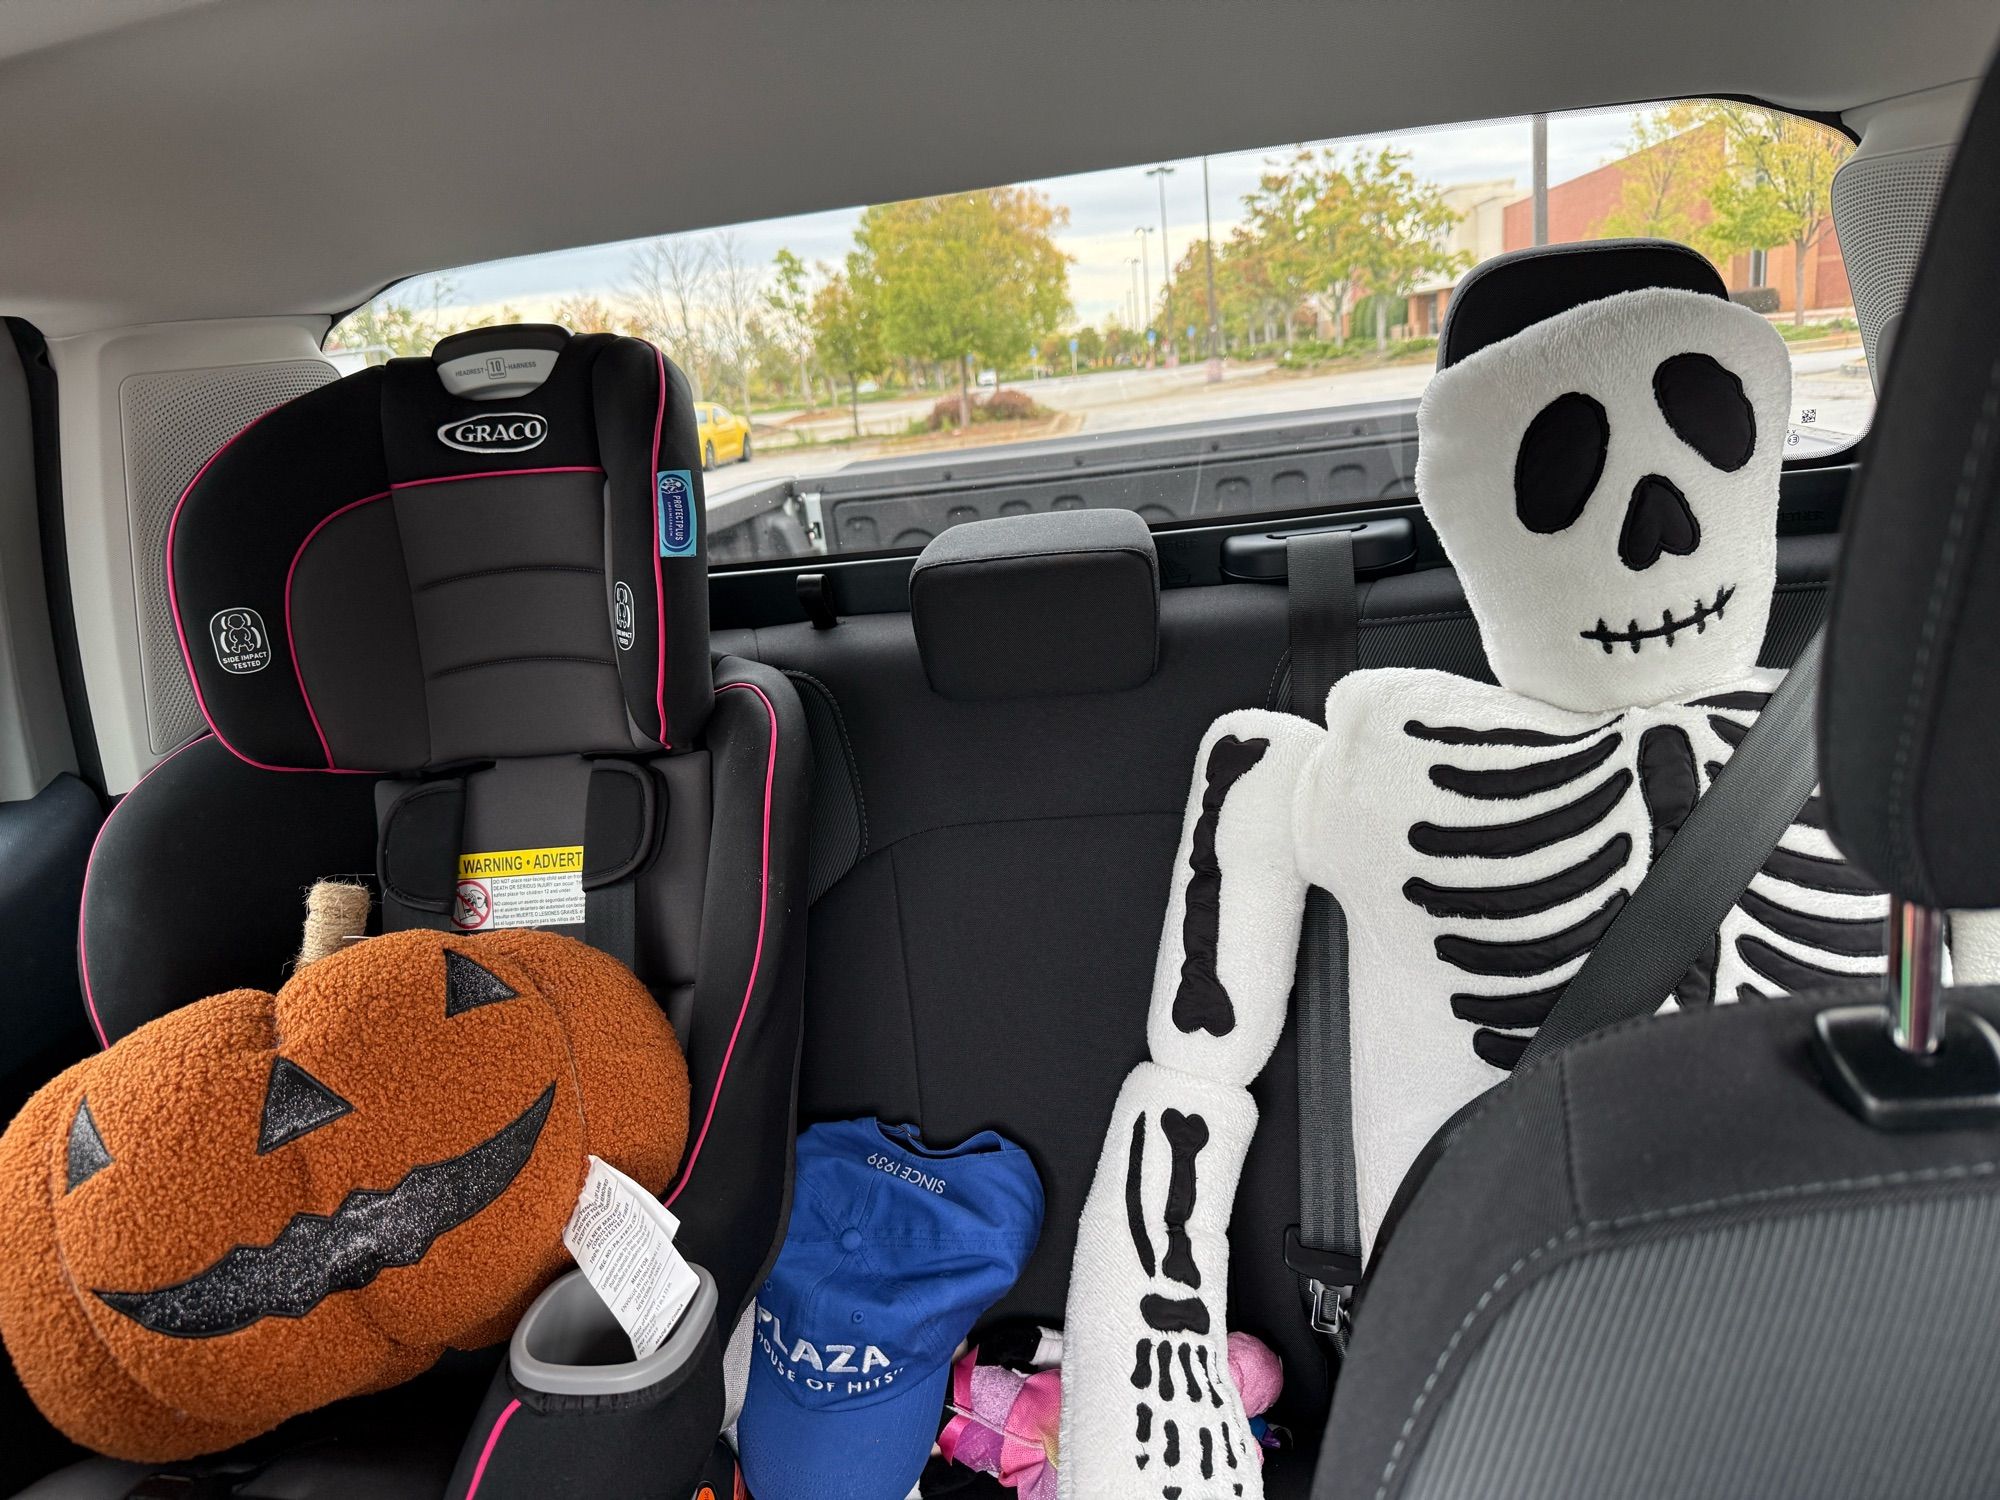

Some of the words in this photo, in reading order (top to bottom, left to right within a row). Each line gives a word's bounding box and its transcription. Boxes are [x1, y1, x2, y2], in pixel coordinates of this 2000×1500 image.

[455, 367, 484, 377] HEADREST
[490, 360, 501, 372] 10
[508, 361, 536, 370] HARNESS
[455, 420, 541, 443] GRACO
[223, 656, 240, 664] SIDE
[241, 651, 267, 661] IMPACT
[233, 660, 261, 670] TESTED
[463, 856, 522, 874] WARNING
[533, 852, 582, 869] ADVERT
[571, 1214, 581, 1232] UNDER
[576, 1220, 584, 1232] TAG
[581, 1211, 590, 1222] NOT
[589, 1205, 597, 1213] TO
[576, 1225, 587, 1245] EXCEPT
[584, 1219, 592, 1227] BY
[590, 1210, 601, 1220] THE
[585, 1237, 593, 1248] ALL
[590, 1224, 601, 1238] NEW
[601, 1200, 621, 1226] MATERIAL
[590, 1218, 617, 1249] CONSISTING
[615, 1210, 622, 1220] OF
[589, 1247, 599, 1265] 100%
[597, 1218, 624, 1248] POLYESTER
[630, 1267, 642, 1284] MADE
[639, 1256, 648, 1269] FOR
[656, 1328, 667, 1345] MADE
[672, 1303, 683, 1322] CHINA
[757, 1305, 891, 1374] PLAZA
[807, 1378, 836, 1392] OF
